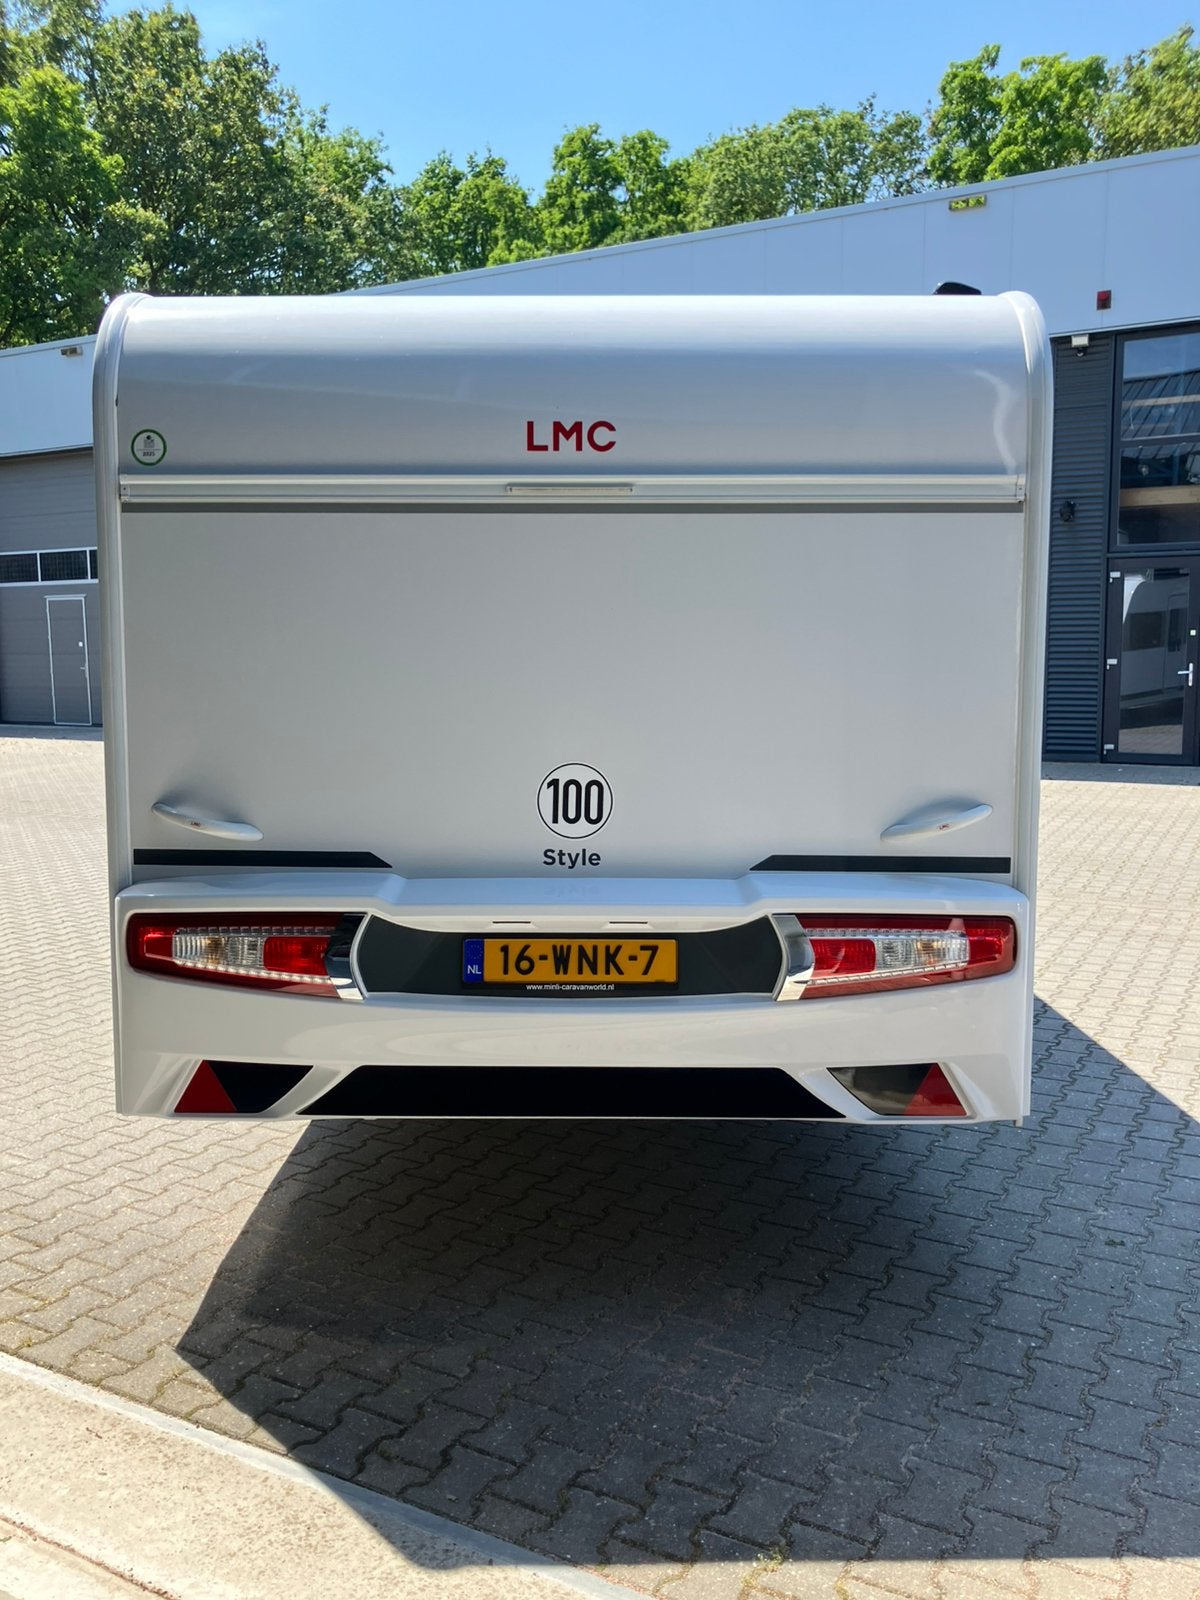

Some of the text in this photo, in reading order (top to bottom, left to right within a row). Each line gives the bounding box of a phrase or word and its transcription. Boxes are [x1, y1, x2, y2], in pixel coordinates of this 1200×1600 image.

[527, 420, 616, 452] LMC
[547, 778, 604, 825] 100
[542, 848, 601, 869] Style
[467, 965, 482, 975] NL
[500, 944, 659, 975] 16-WNK-7
